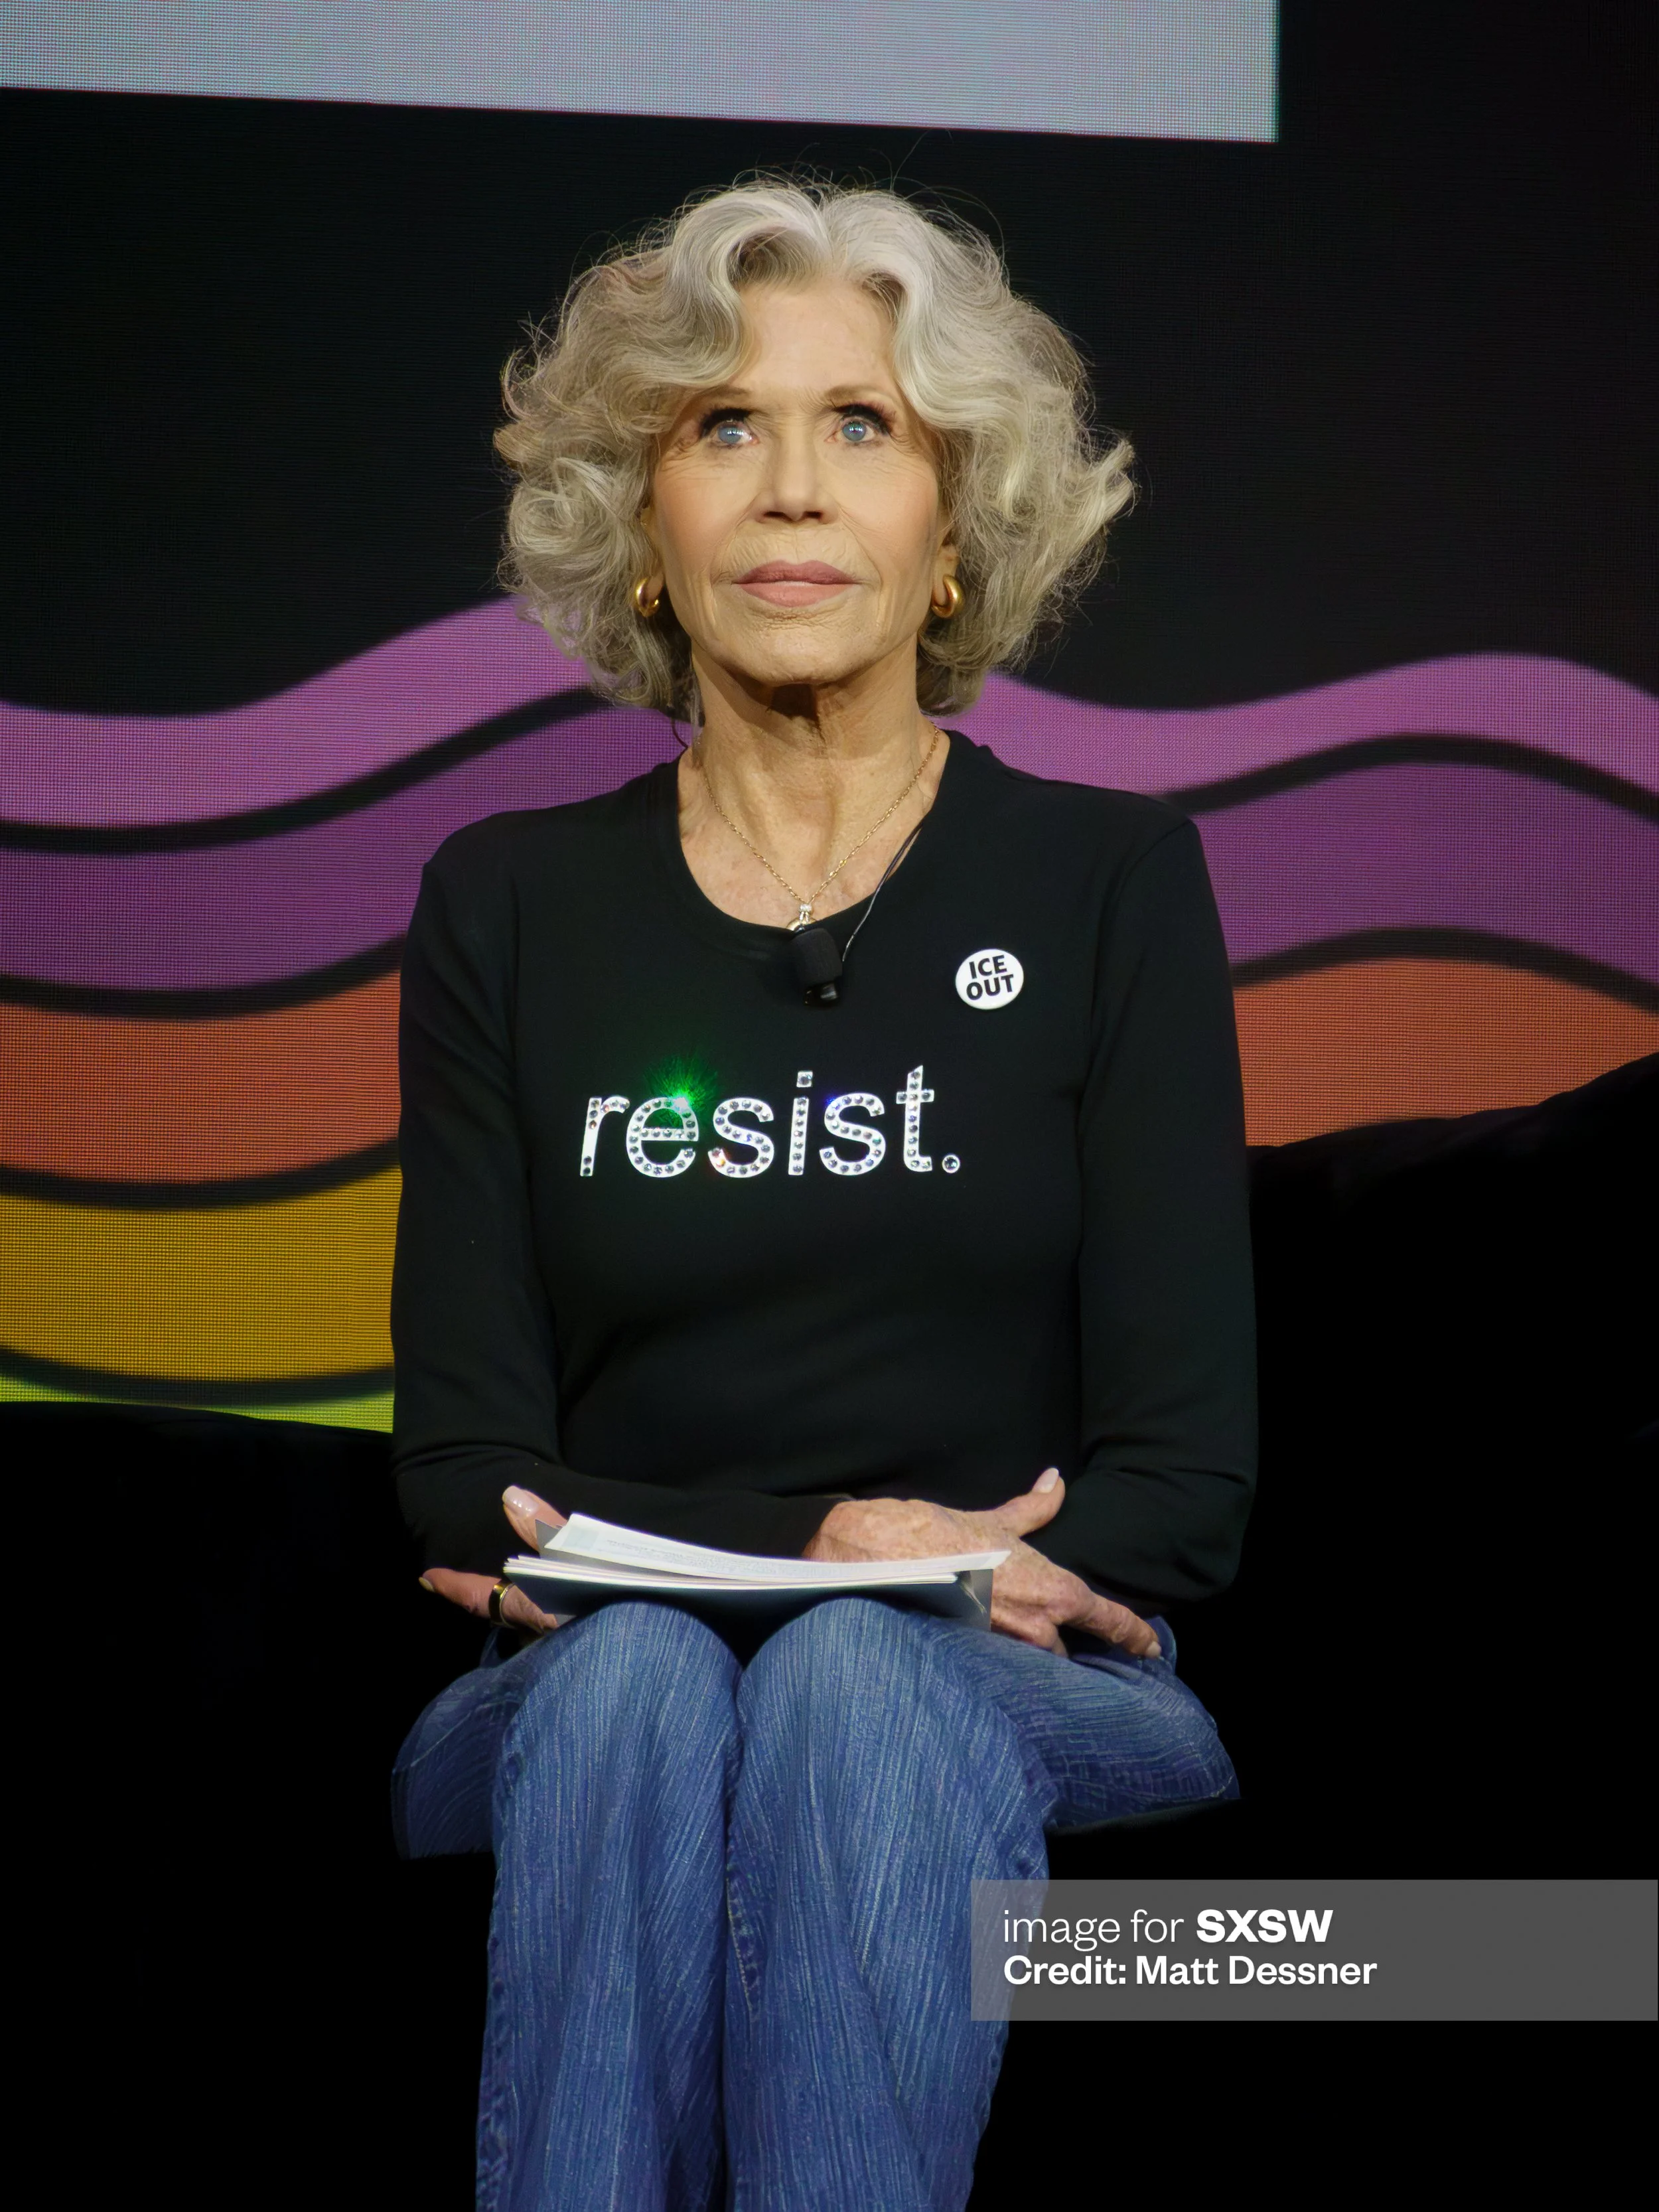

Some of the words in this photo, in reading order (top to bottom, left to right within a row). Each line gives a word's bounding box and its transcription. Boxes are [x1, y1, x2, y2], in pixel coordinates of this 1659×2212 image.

[969, 954, 1007, 979] ICE
[966, 974, 1014, 1000] OUT
[580, 1065, 961, 1177] resist.
